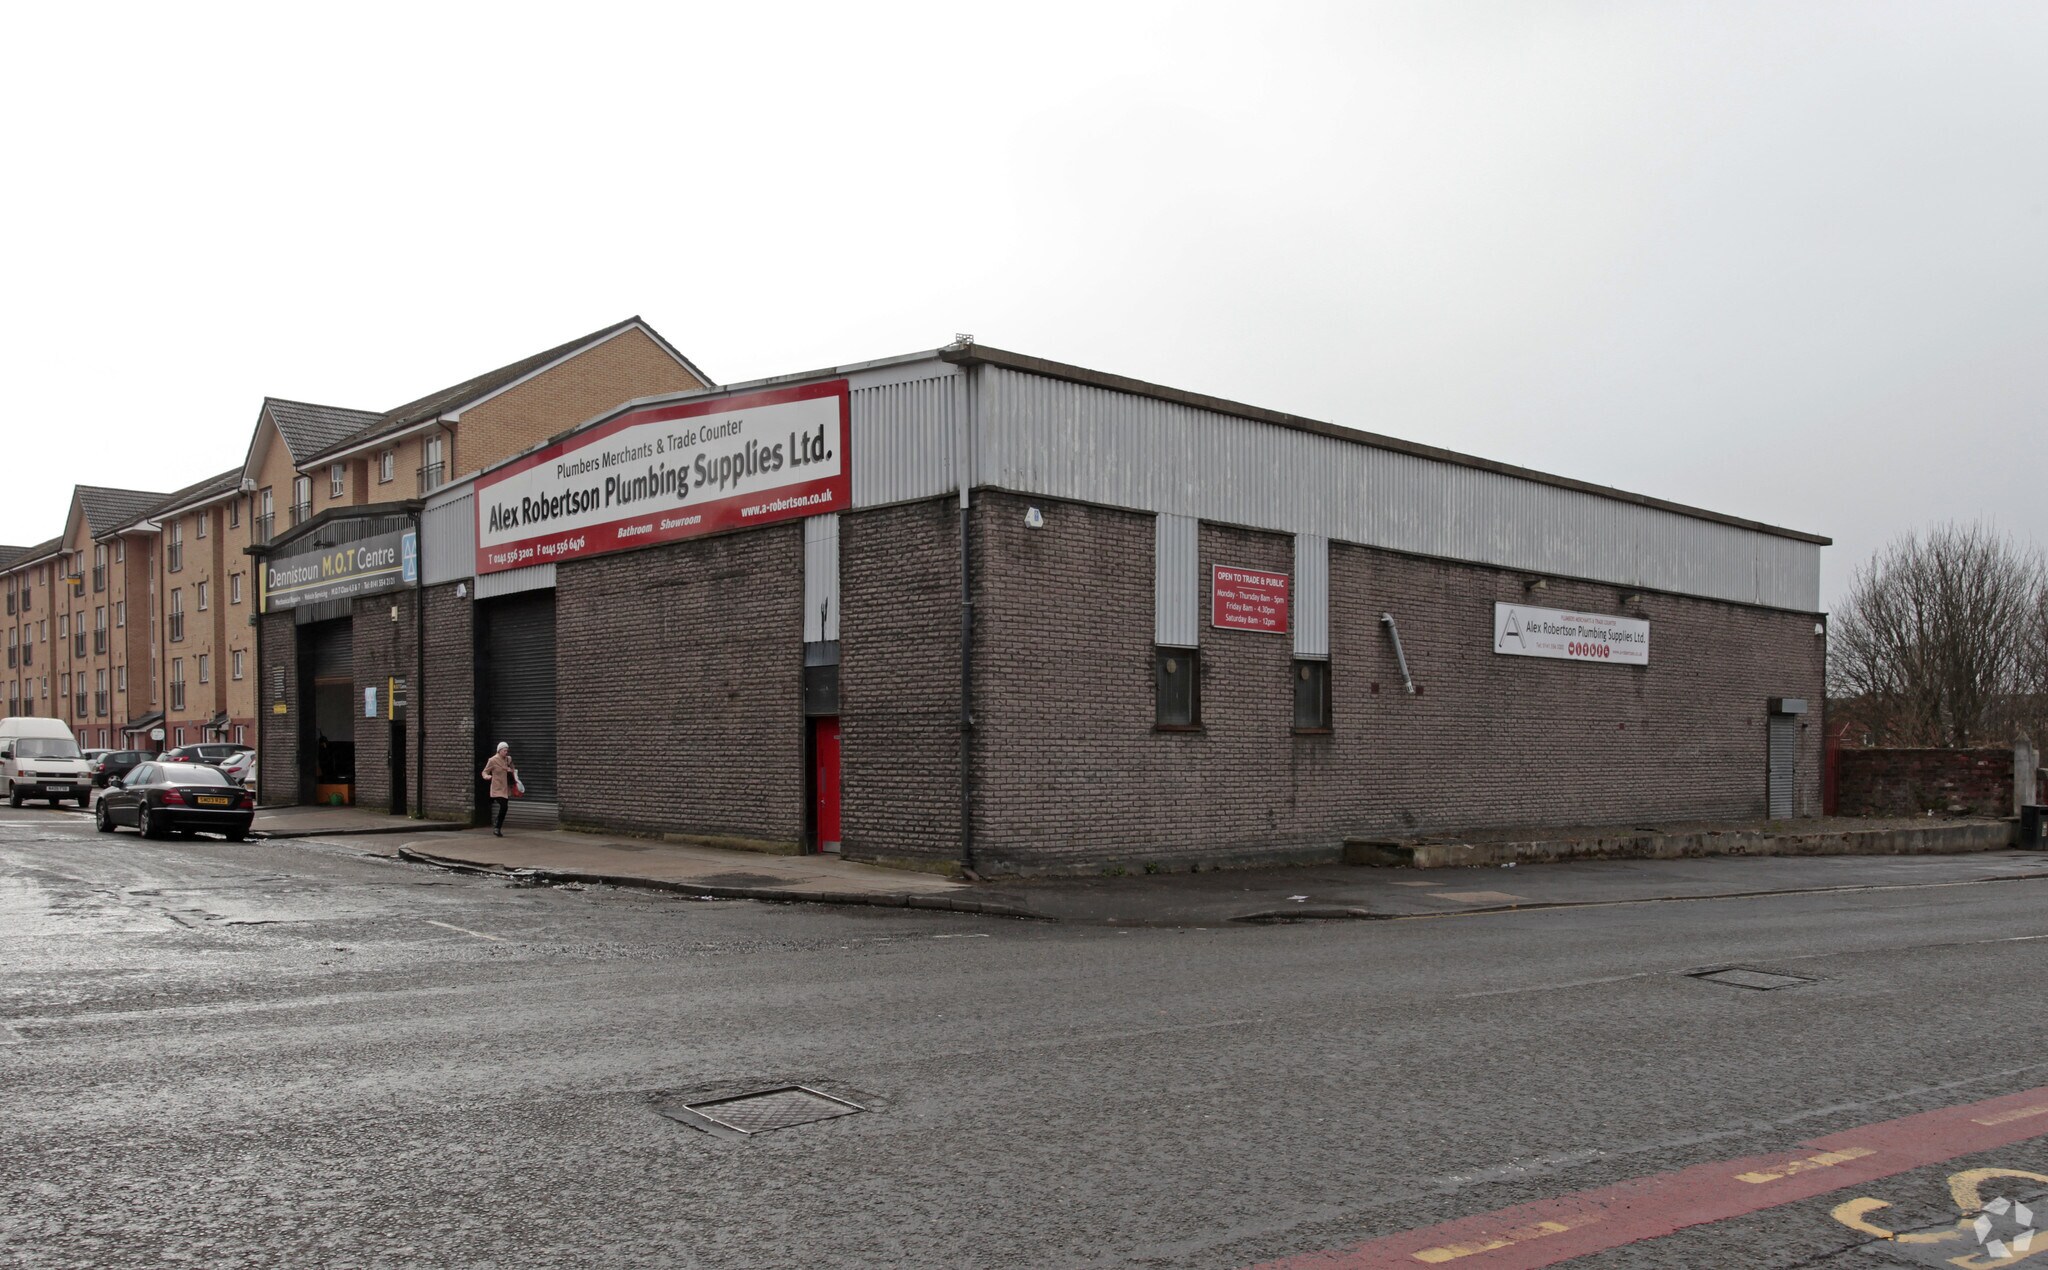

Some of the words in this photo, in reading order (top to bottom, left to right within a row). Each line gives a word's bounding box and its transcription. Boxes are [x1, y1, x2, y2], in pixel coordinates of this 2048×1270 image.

[557, 456, 600, 479] Plumbers
[602, 442, 653, 468] Merchants
[657, 439, 664, 454] &
[668, 429, 697, 451] Trade
[700, 420, 743, 441] Counter
[489, 503, 519, 534] Alex
[522, 486, 600, 526] Robertson
[605, 464, 689, 508] Plumbing
[694, 439, 783, 490] Supplies
[790, 424, 832, 467] Ltd.
[741, 489, 832, 518] www.a-robertson.co.uk
[617, 522, 652, 539] Bathroom
[660, 513, 701, 530] Showroom
[489, 554, 492, 564] T
[494, 554, 506, 564] 0141
[508, 548, 517, 563] 556
[519, 548, 533, 561] 3202
[538, 544, 541, 555] F
[542, 544, 555, 556] 0141
[557, 539, 567, 554] 556
[568, 536, 585, 551] 6476
[269, 563, 318, 588] Dennistoun
[322, 549, 355, 577] M.O.T
[358, 547, 394, 569] Centre
[1218, 572, 1232, 581] OPEN
[1243, 575, 1259, 584] TRADE
[1266, 578, 1284, 587] PUBLIC
[1217, 590, 1235, 599] Monday
[1239, 592, 1259, 602] Thursday
[1274, 596, 1284, 604] 5pm
[1226, 602, 1241, 612] Friday
[1257, 605, 1275, 615] 4.30pm
[1226, 614, 1246, 624] Saturday
[1263, 618, 1275, 626] 12pm
[1526, 621, 1541, 633] Alex
[1544, 622, 1576, 636] Robertson
[1578, 626, 1606, 642] Plumbing
[1608, 629, 1632, 642] Supplies
[1634, 632, 1645, 643] Ltd.
